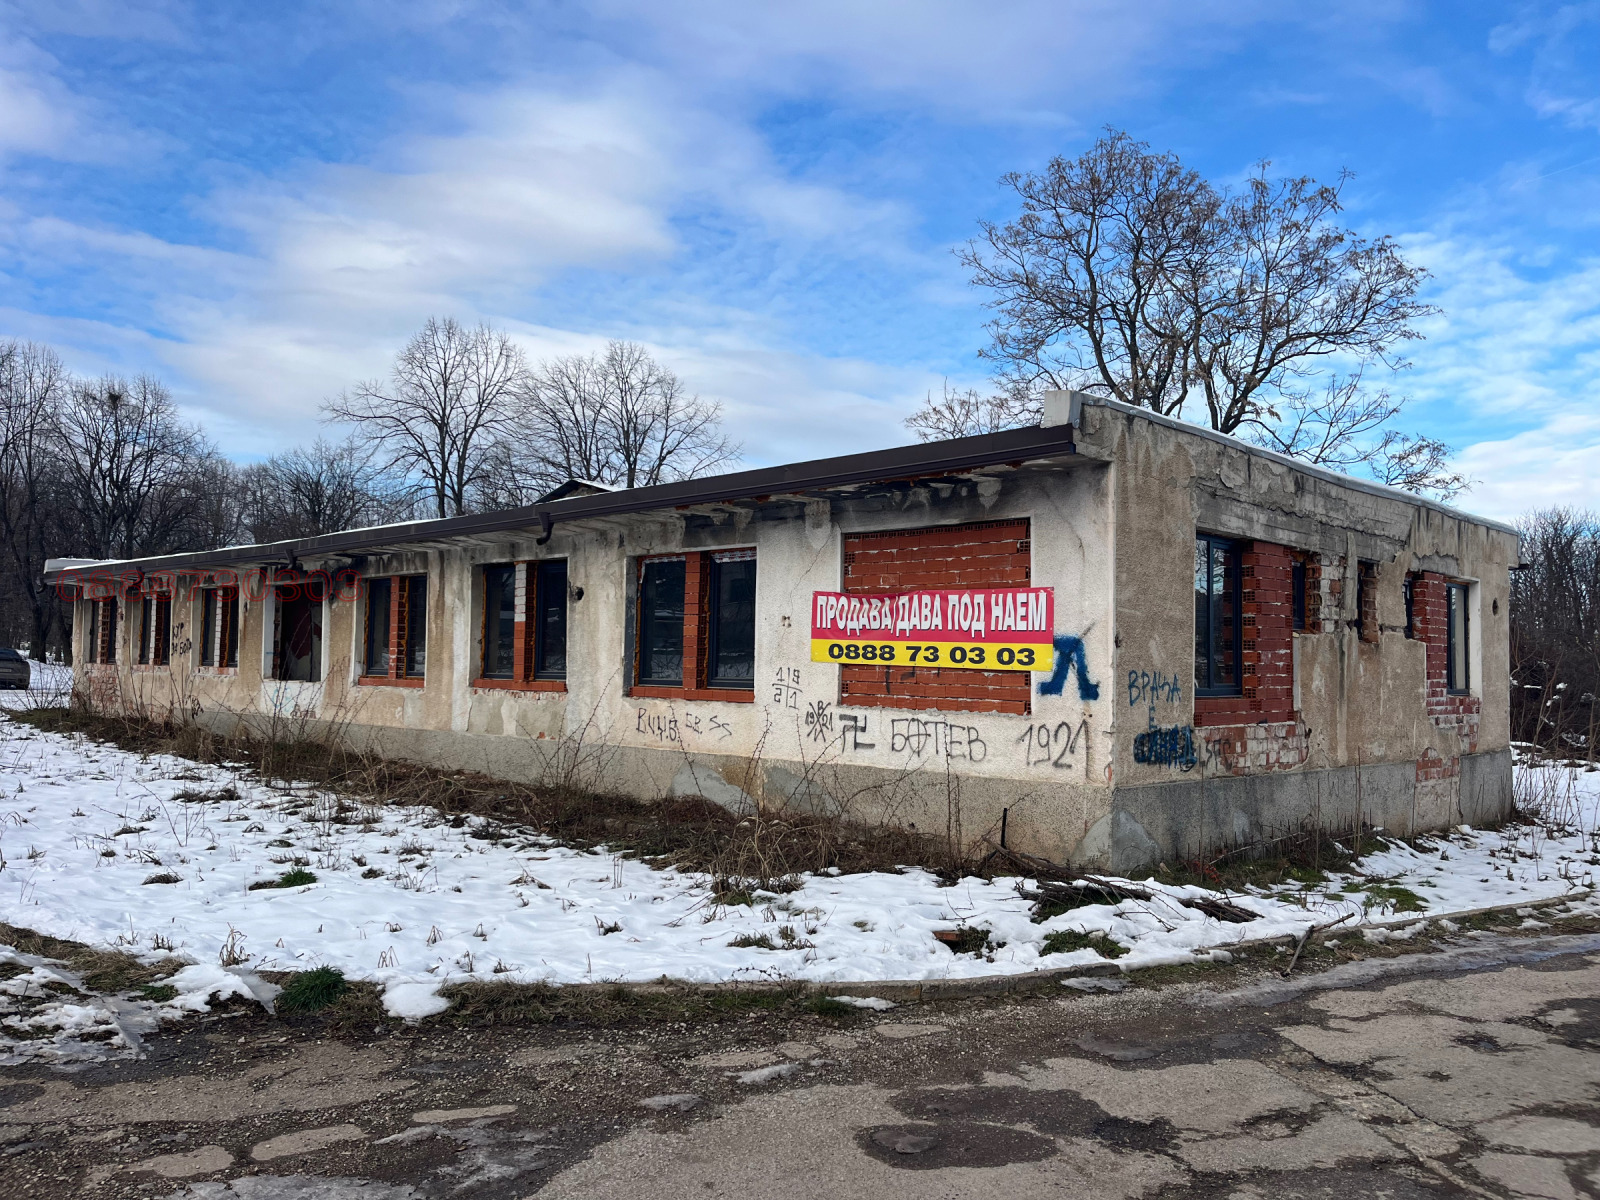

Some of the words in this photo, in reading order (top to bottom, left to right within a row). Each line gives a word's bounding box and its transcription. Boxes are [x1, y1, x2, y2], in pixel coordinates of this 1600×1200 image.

[948, 594, 986, 638] ПОД
[991, 592, 1047, 631] НАЕМ
[828, 643, 896, 662] 0888
[906, 645, 940, 663] 73
[950, 646, 986, 665] 03
[996, 648, 1036, 666] 03
[1015, 719, 1091, 772] 1921
